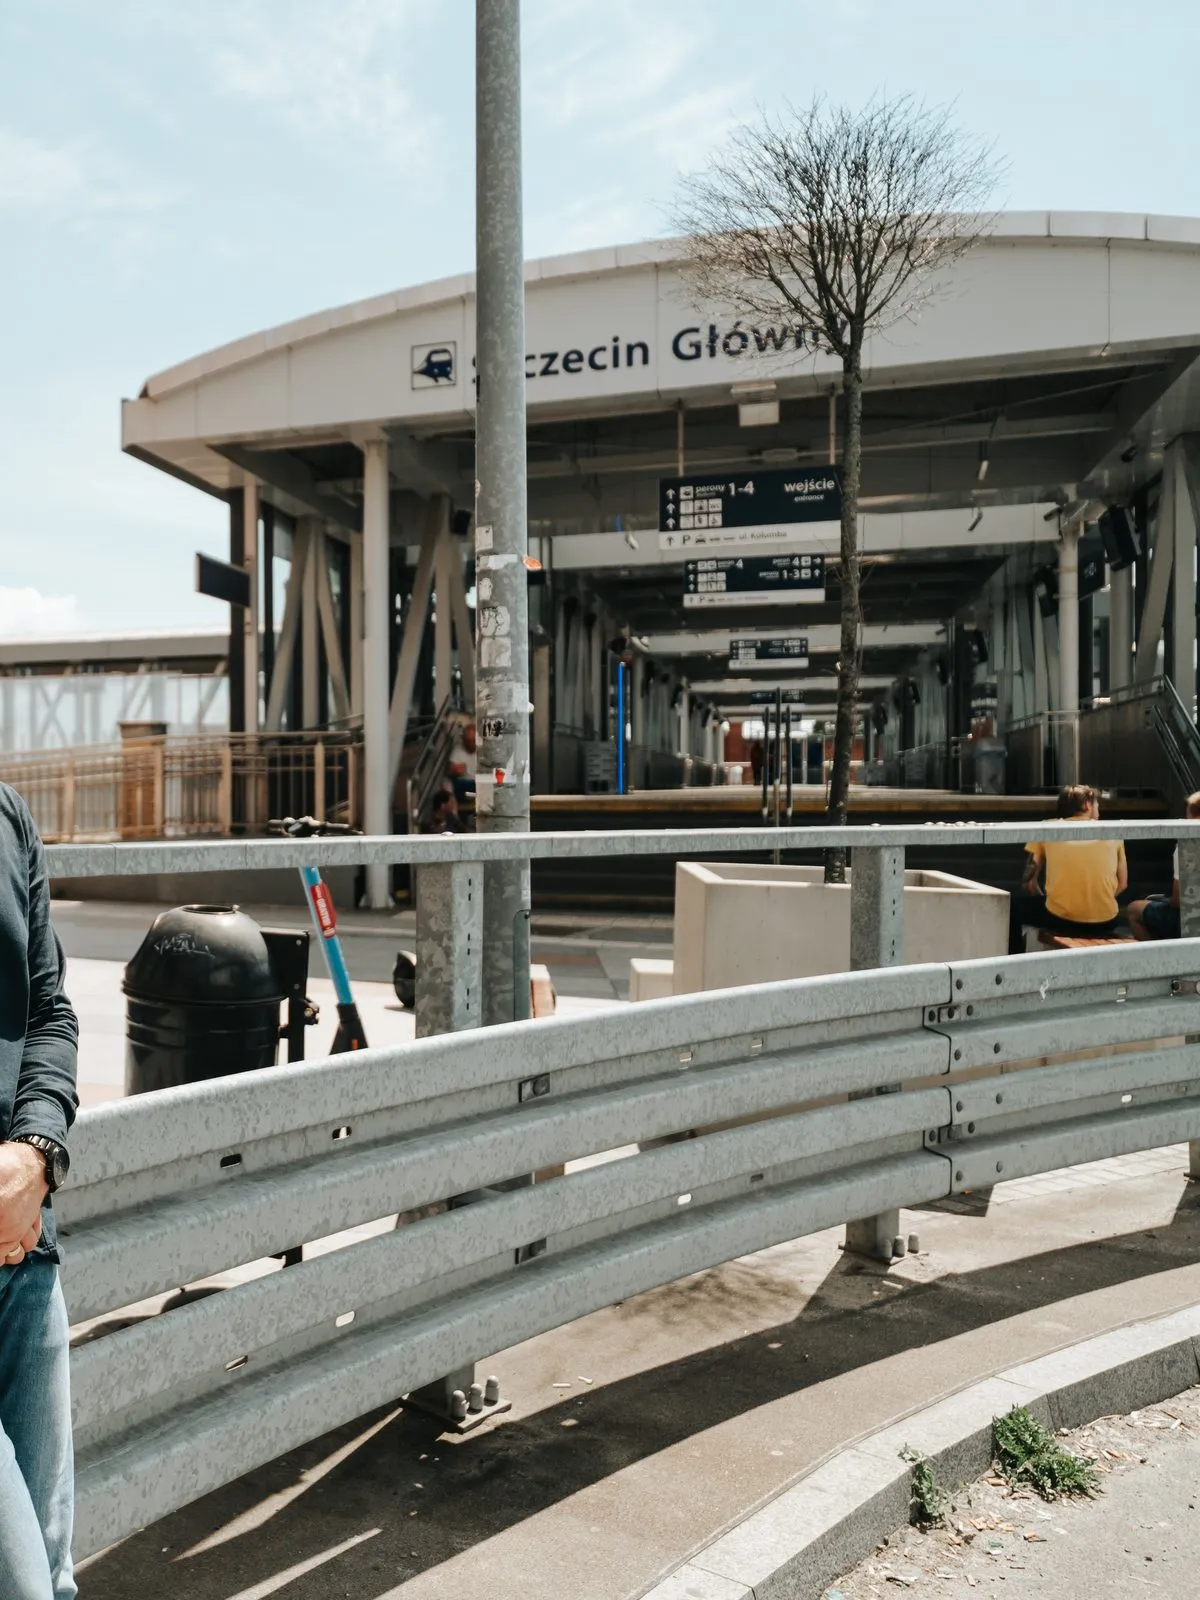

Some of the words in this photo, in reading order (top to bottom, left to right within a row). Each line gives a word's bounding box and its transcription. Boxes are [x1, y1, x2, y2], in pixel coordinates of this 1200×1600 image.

[695, 483, 725, 495] perony
[728, 480, 755, 497] 1-4
[784, 476, 836, 495] wejście
[794, 493, 825, 502] entrance
[792, 556, 800, 566] 4
[782, 568, 800, 580] 1-3
